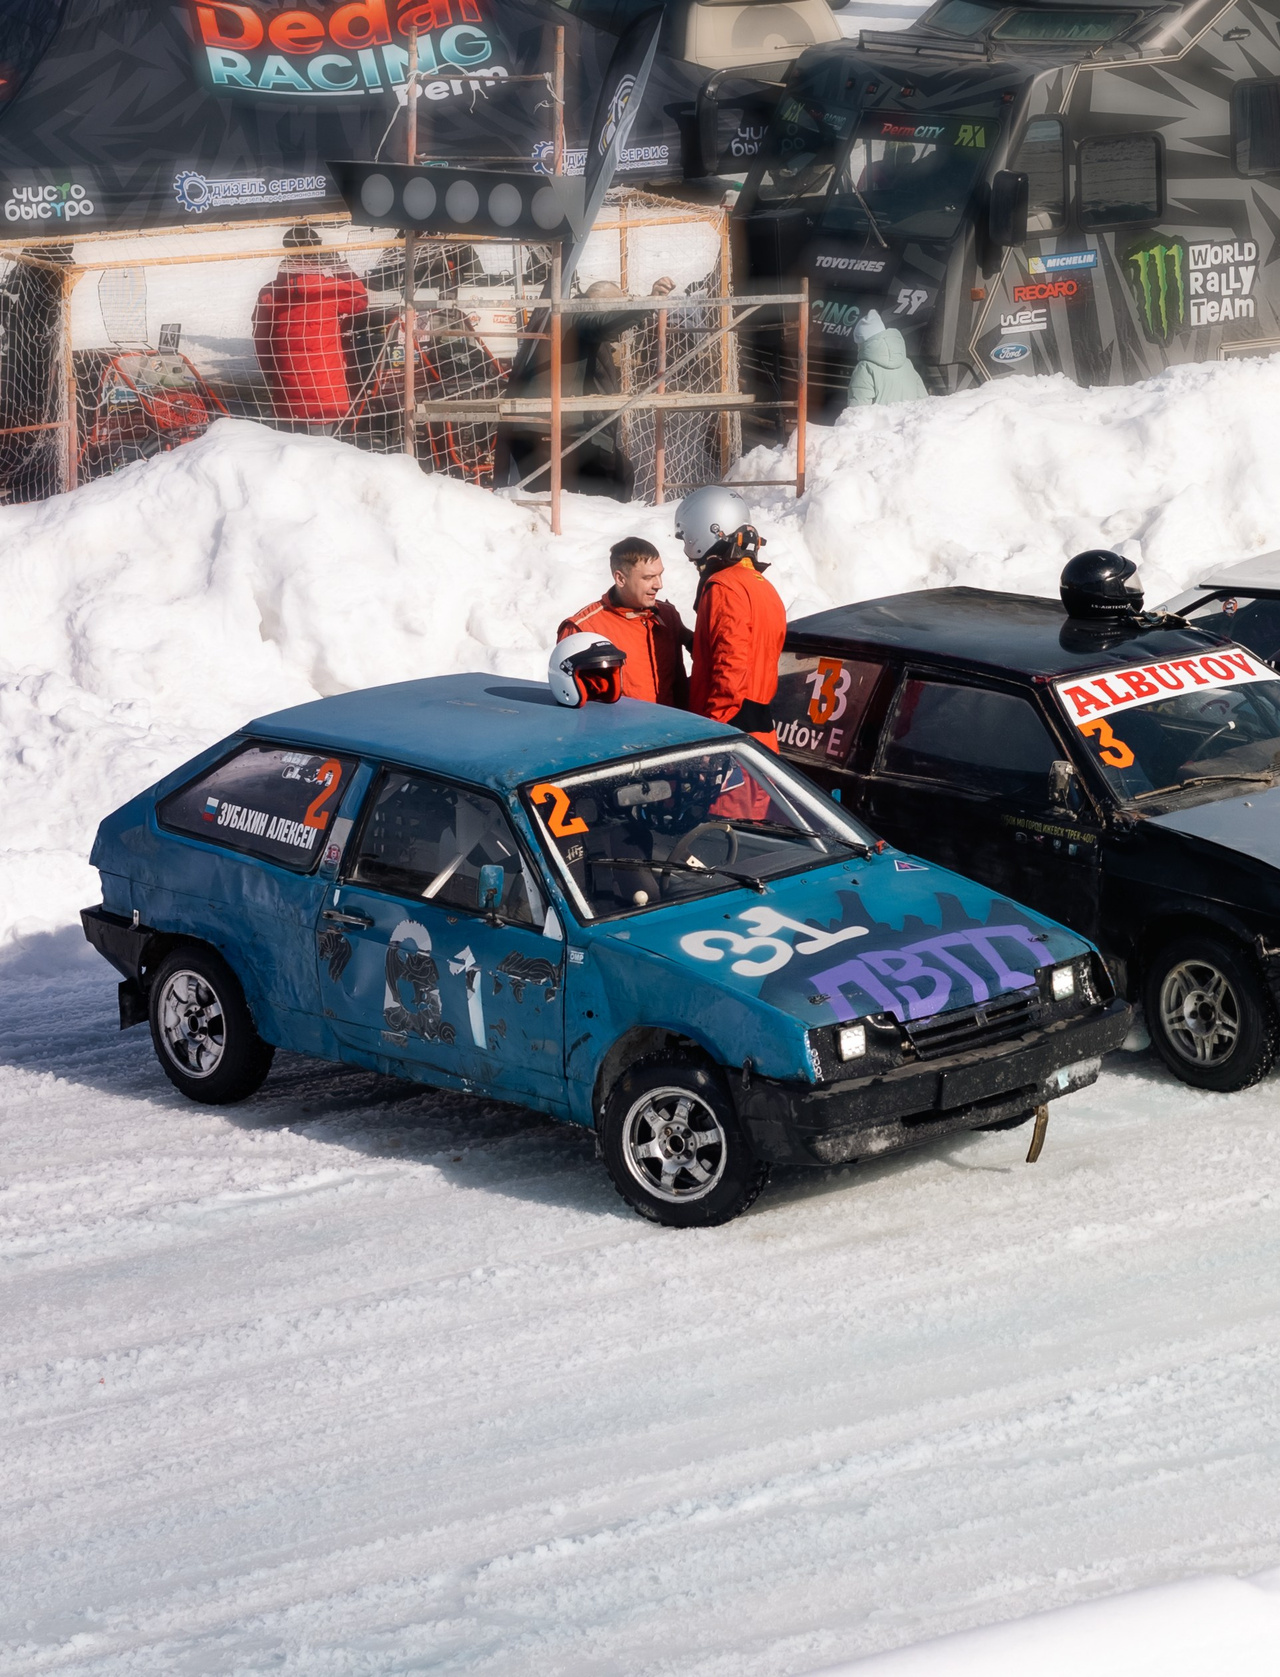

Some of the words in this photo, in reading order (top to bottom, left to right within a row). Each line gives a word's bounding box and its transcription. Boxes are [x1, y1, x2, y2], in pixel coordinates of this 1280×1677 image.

[206, 24, 492, 91] RACING
[212, 181, 267, 199] ДИЗЕЛЬ
[268, 175, 327, 194] СЕРВИС
[1046, 254, 1095, 268] MICHELIN
[1189, 242, 1257, 270] WORLD
[893, 288, 929, 315] 59
[1014, 280, 1078, 302] RECARO
[821, 321, 853, 337] TEAM
[1001, 309, 1047, 327] WRC
[999, 346, 1022, 360] Ford
[809, 658, 843, 725] 3
[1063, 653, 1257, 718] ALBUTOV
[826, 727, 844, 758] E.
[1077, 718, 1135, 768] 3
[303, 758, 342, 830] 2
[217, 801, 268, 837] ЗУБАХИН
[530, 783, 589, 838] 2
[680, 906, 869, 978] 31
